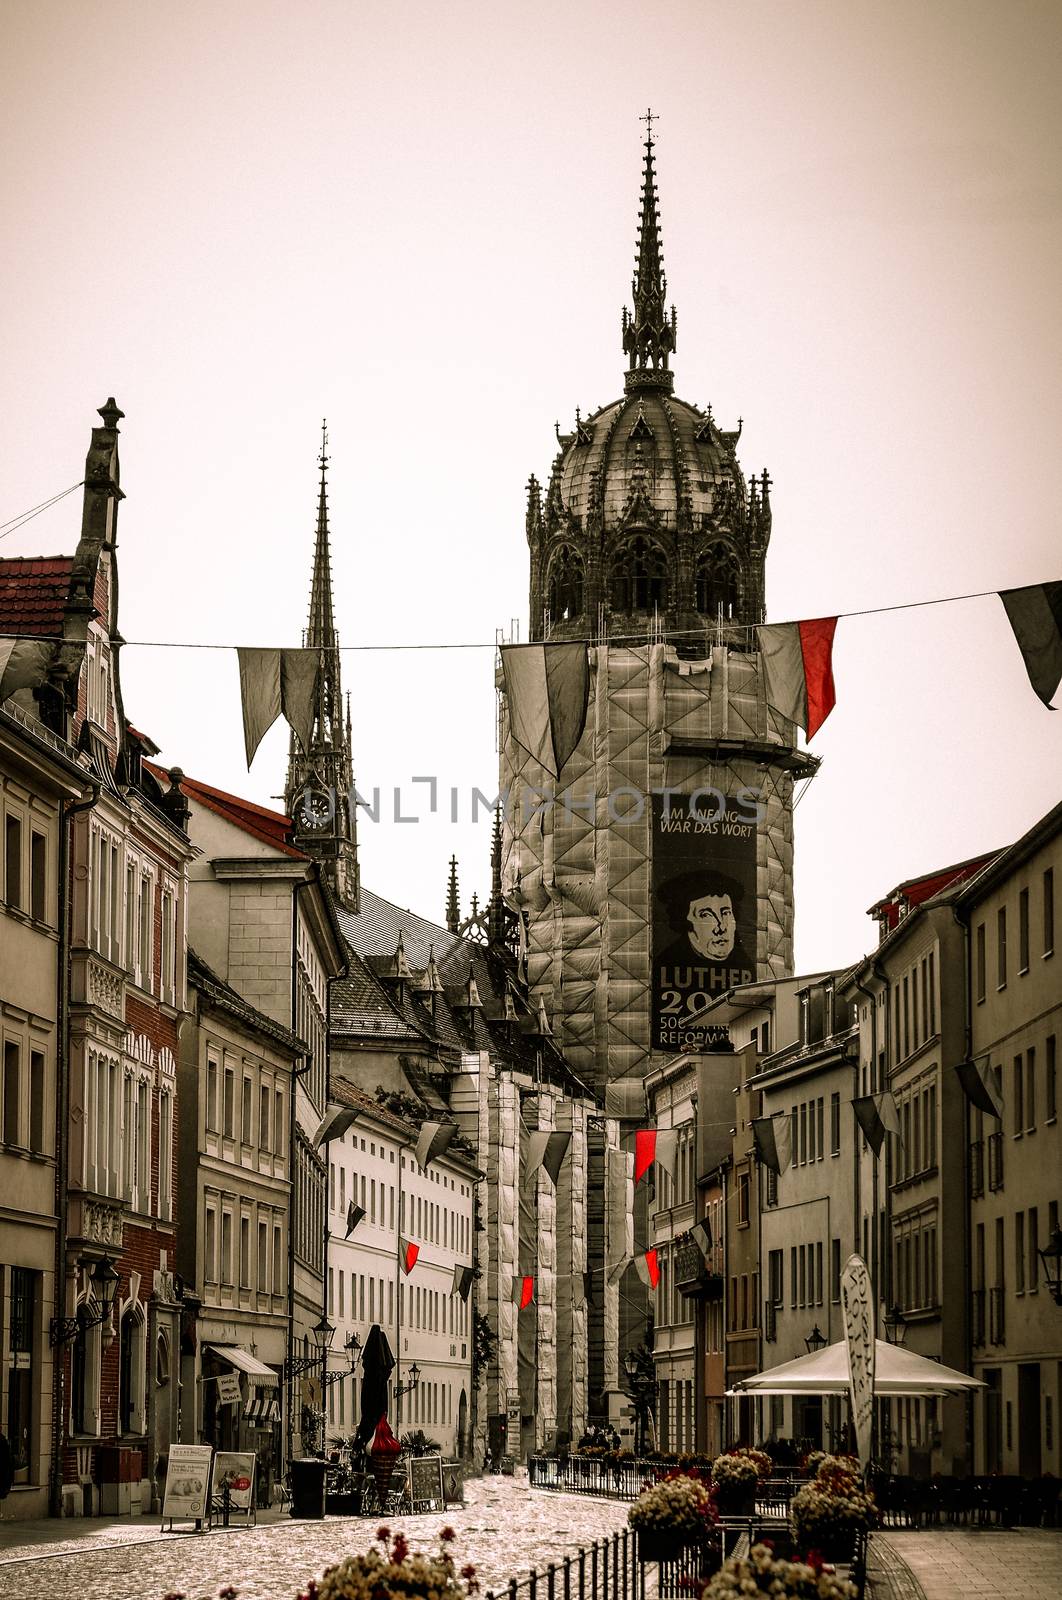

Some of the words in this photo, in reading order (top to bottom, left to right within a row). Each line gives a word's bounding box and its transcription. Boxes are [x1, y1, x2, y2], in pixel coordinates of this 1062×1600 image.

[660, 807, 683, 820] AM
[687, 808, 738, 823] ANFANG
[660, 821, 690, 833] WAR
[694, 822, 719, 834] DAS
[721, 823, 753, 838] WORT
[661, 966, 753, 989] LUTHER
[660, 991, 713, 1014] 20
[660, 1032, 729, 1044] REFORMA
